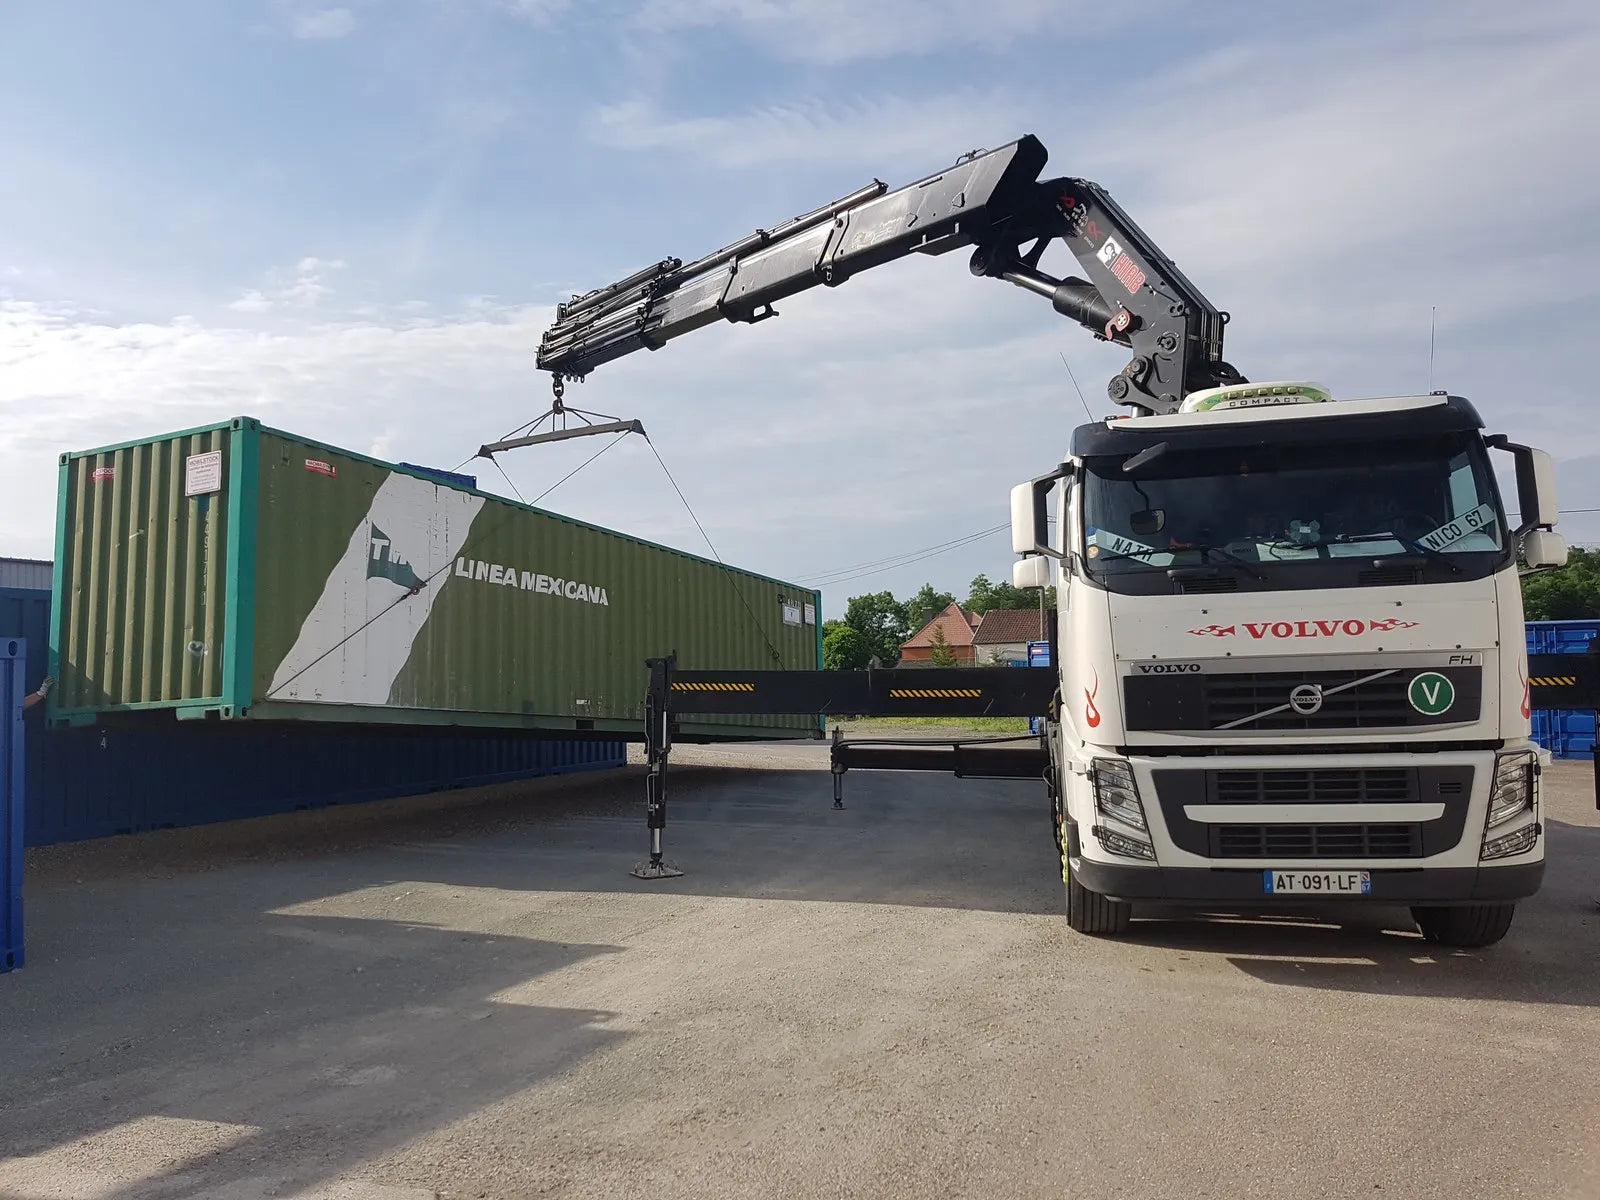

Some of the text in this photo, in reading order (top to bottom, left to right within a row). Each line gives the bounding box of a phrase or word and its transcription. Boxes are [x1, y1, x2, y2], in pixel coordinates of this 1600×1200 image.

[1111, 252, 1146, 294] HIAB
[1229, 397, 1300, 407] COMPACT
[1425, 510, 1483, 549] NICO 67
[455, 556, 609, 606] LINEA MEXICANA
[1241, 619, 1366, 639] VOLVO
[1138, 663, 1201, 674] VOLVO
[1449, 655, 1473, 665] FH
[1421, 681, 1441, 706] V
